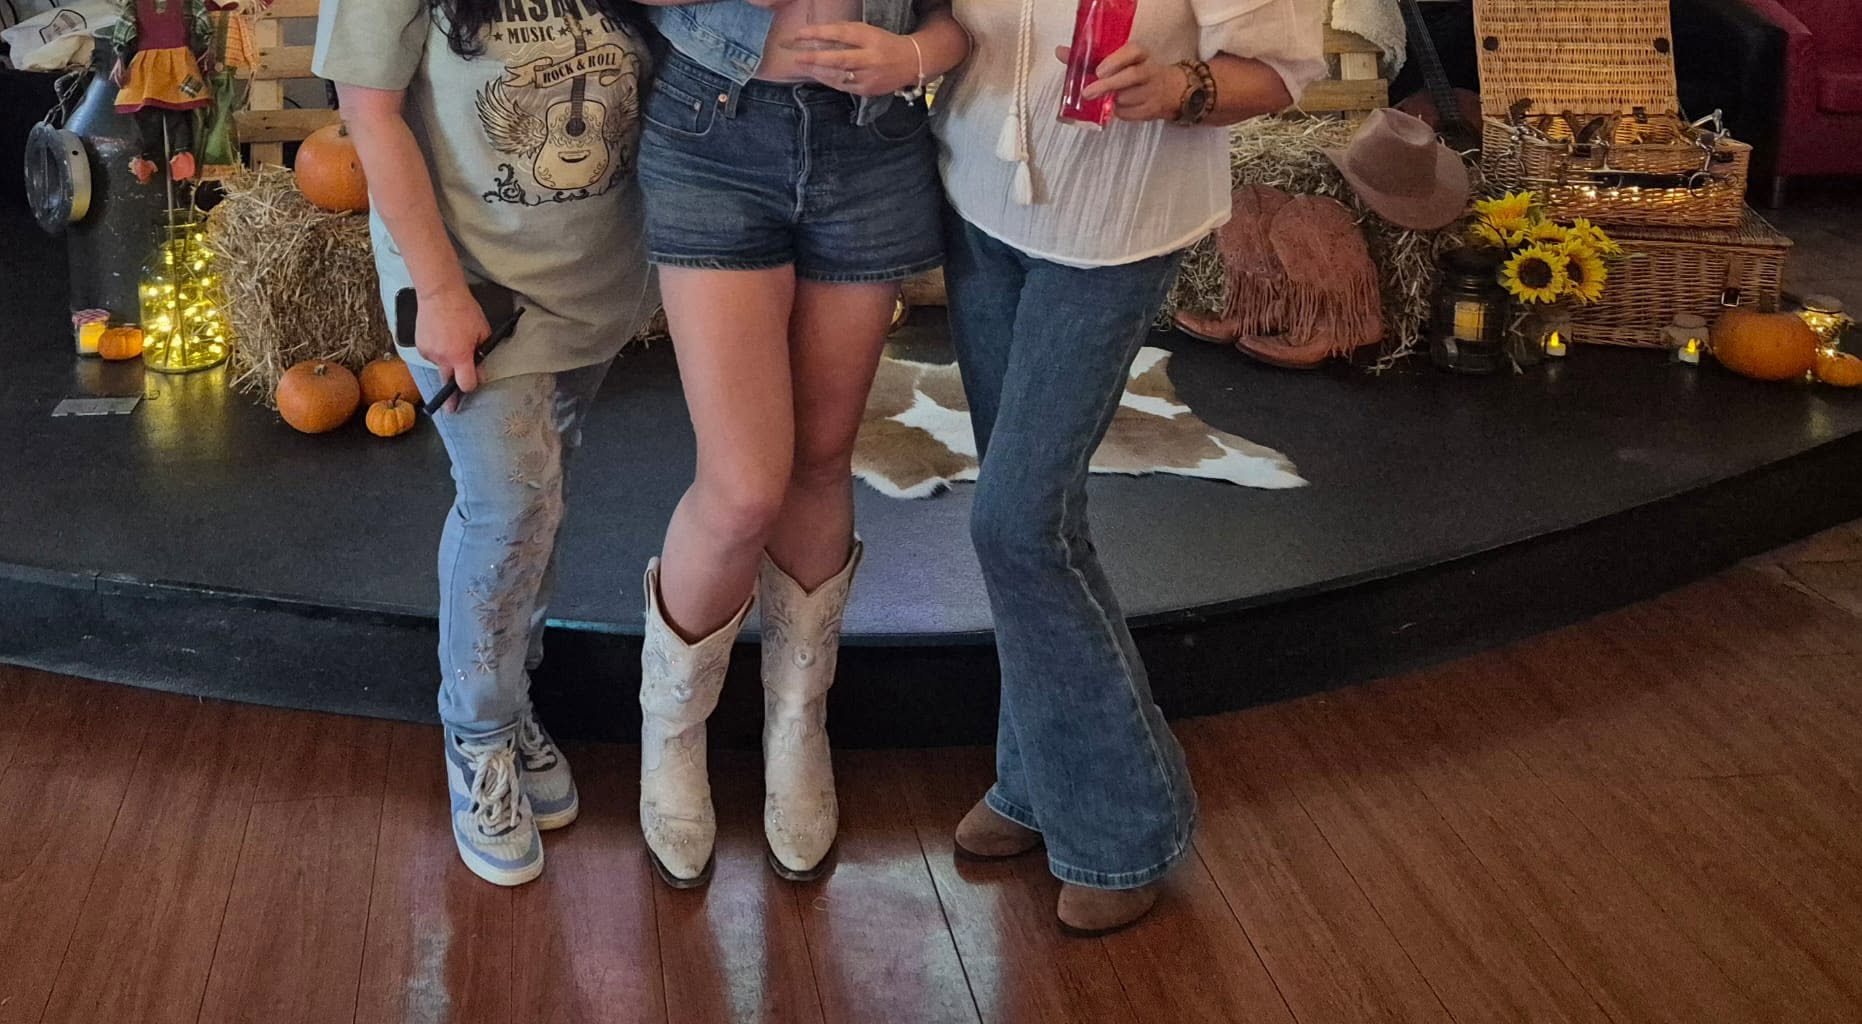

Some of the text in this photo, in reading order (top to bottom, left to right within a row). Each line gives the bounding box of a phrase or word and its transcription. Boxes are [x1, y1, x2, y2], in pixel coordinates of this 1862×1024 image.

[506, 26, 557, 45] MUSIC
[543, 52, 617, 84] ROCK & ROLL
